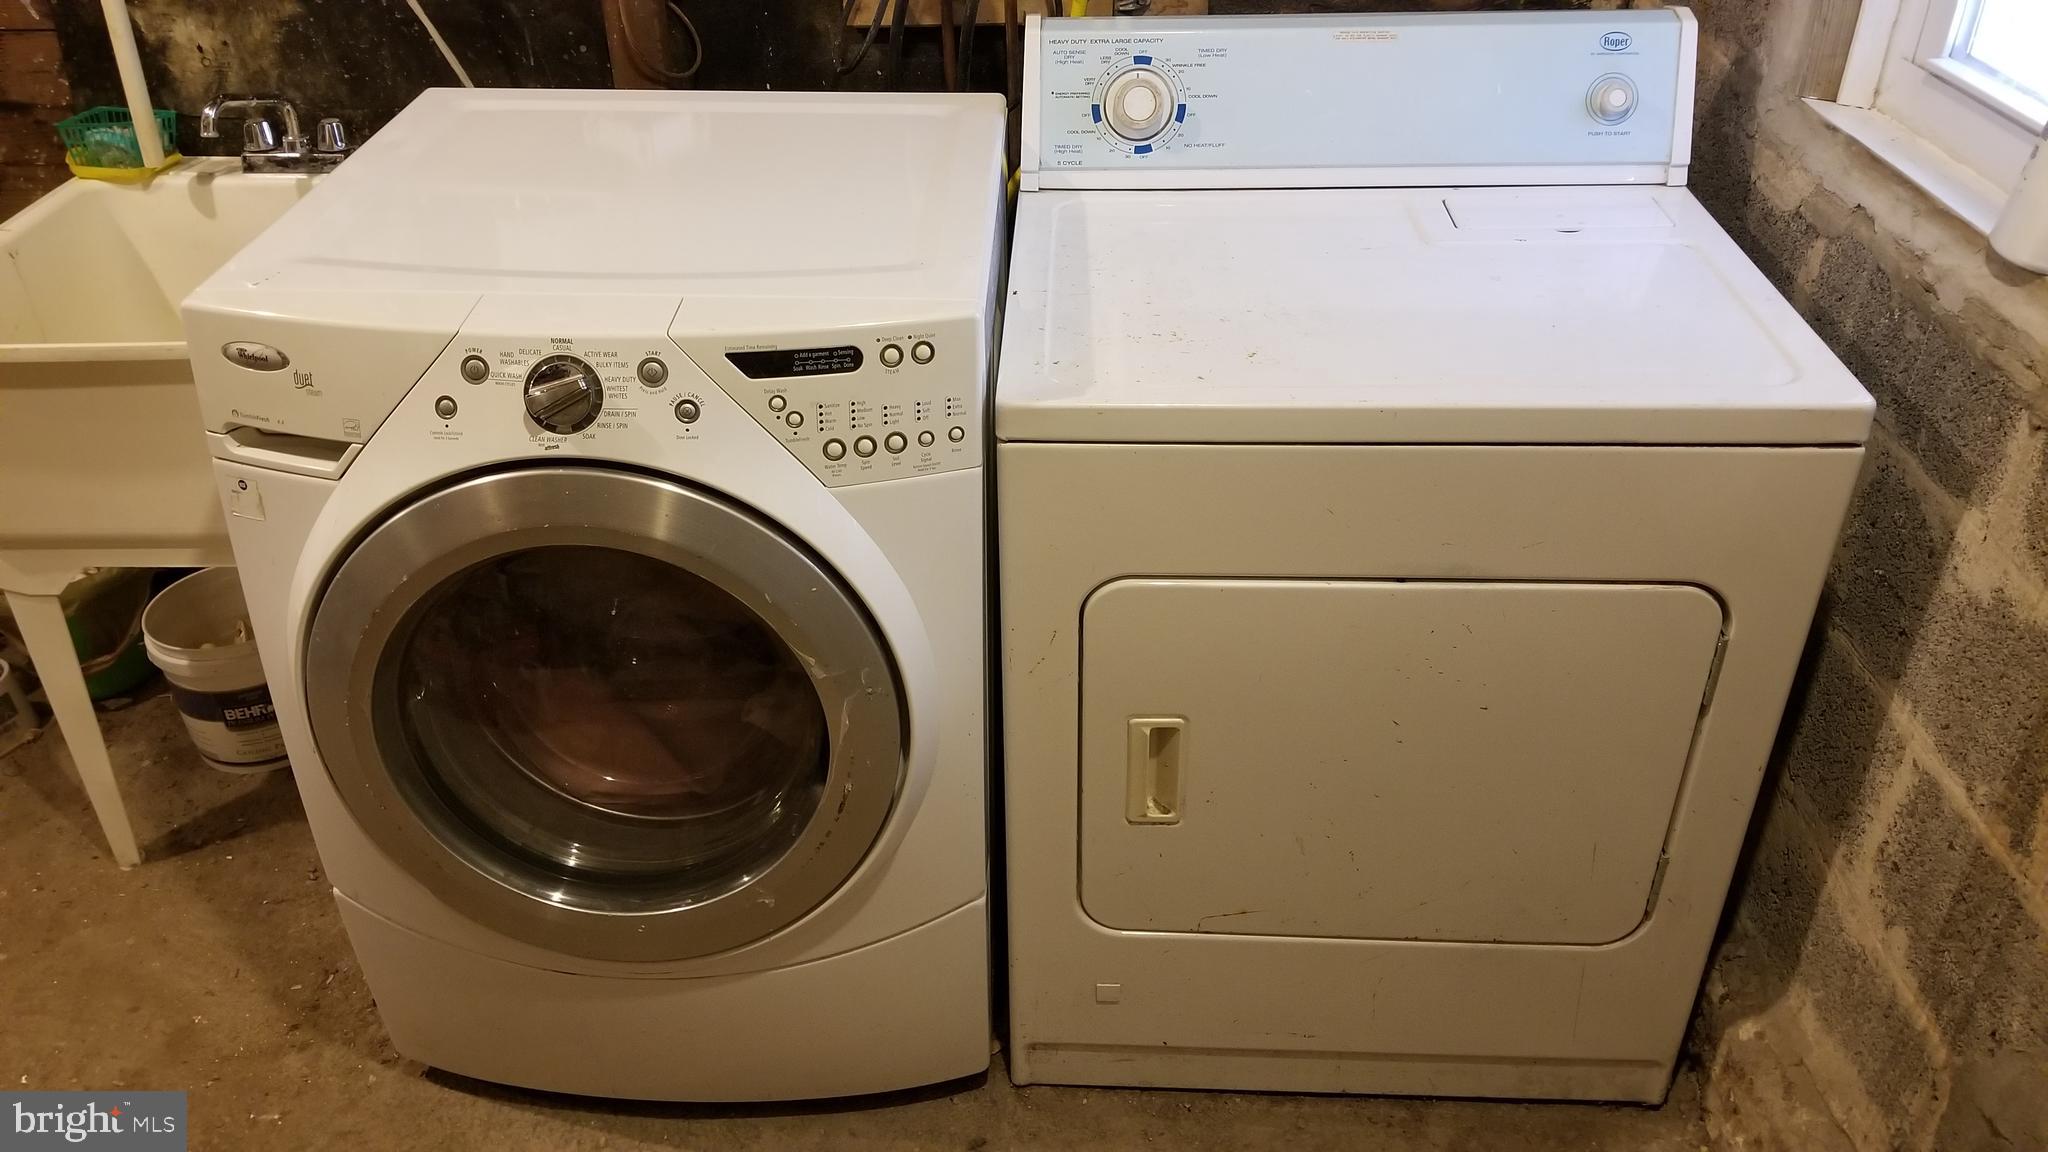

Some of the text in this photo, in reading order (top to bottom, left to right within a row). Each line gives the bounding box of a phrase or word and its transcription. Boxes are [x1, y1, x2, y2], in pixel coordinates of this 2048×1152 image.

[1604, 36, 1629, 48] Roper
[236, 347, 268, 362] Whirlpool
[500, 359, 530, 367] WASHABLES
[293, 369, 314, 386] duet
[669, 393, 683, 407] PAUSE
[687, 392, 705, 407] CANCEL
[224, 704, 267, 720] BEHR
